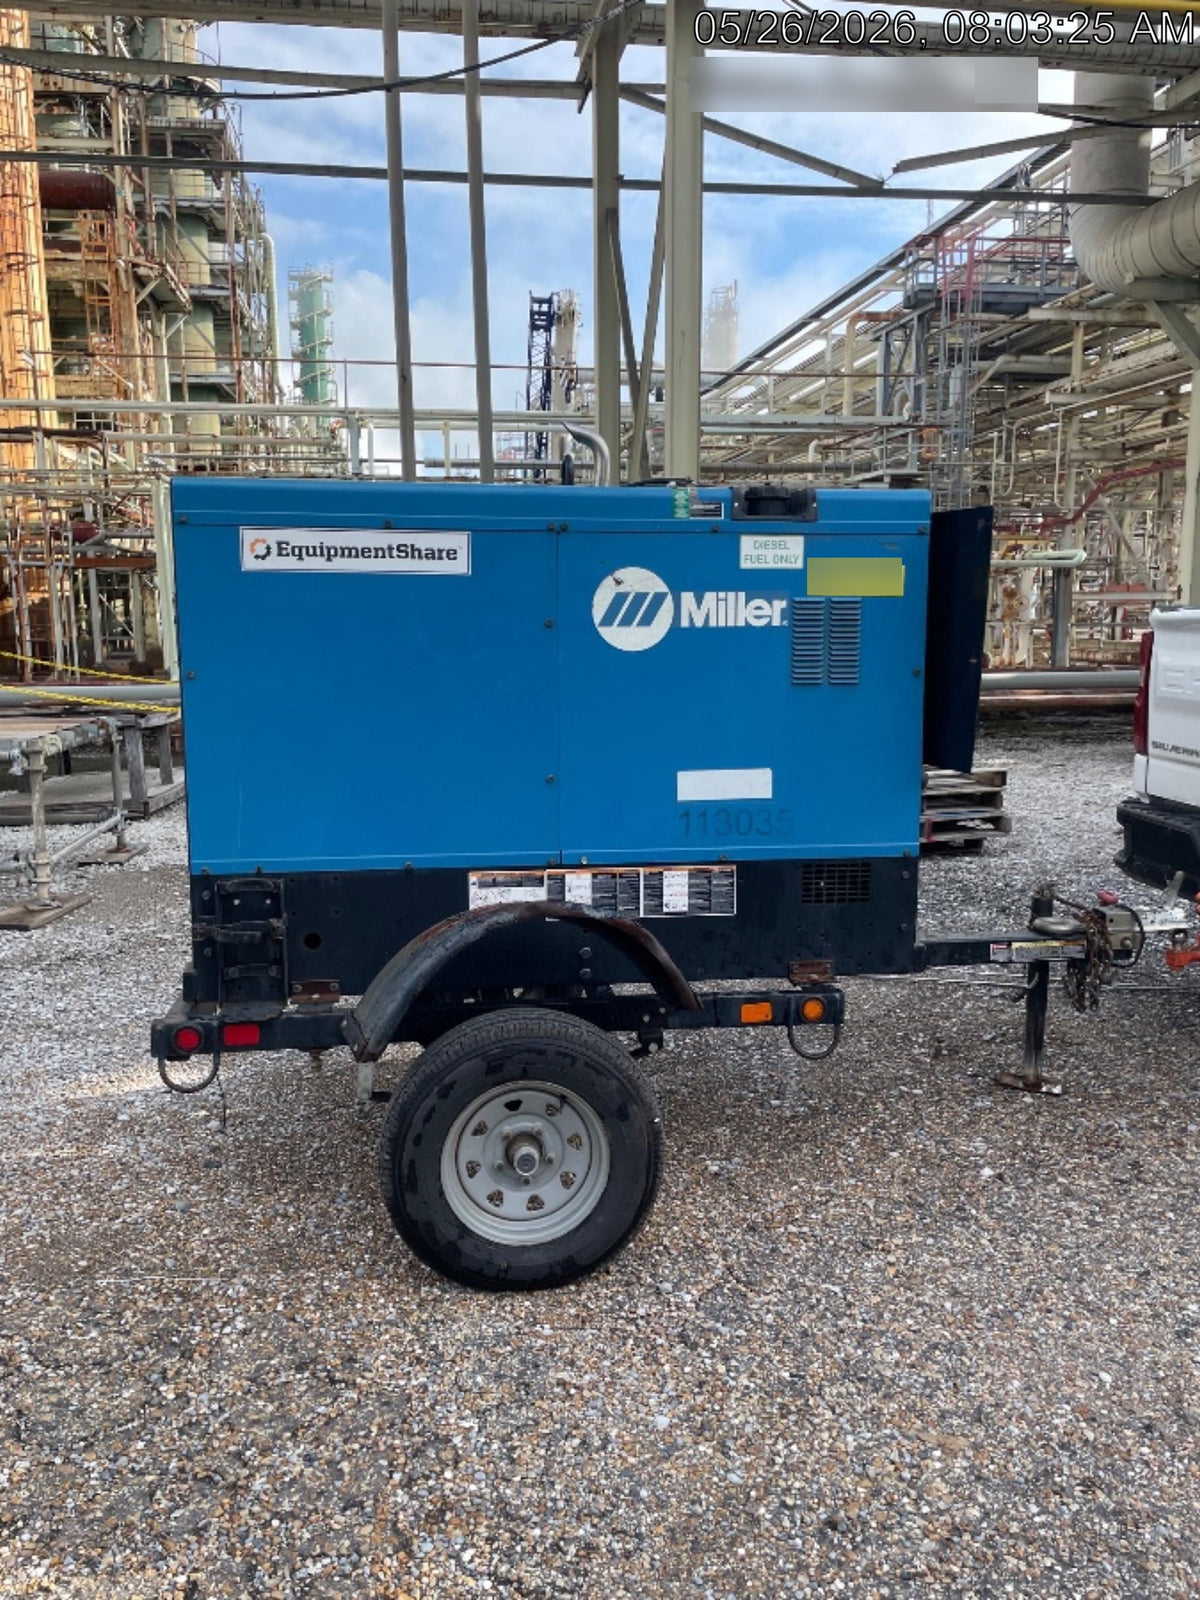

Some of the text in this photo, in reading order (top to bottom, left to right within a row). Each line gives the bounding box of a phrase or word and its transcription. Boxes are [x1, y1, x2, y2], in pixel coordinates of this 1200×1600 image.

[276, 541, 458, 562] EquipmentShare
[753, 540, 790, 550] DIESEL
[744, 554, 800, 565] FUEL ONLY
[680, 591, 787, 627] Miller
[679, 808, 794, 838] 113035
